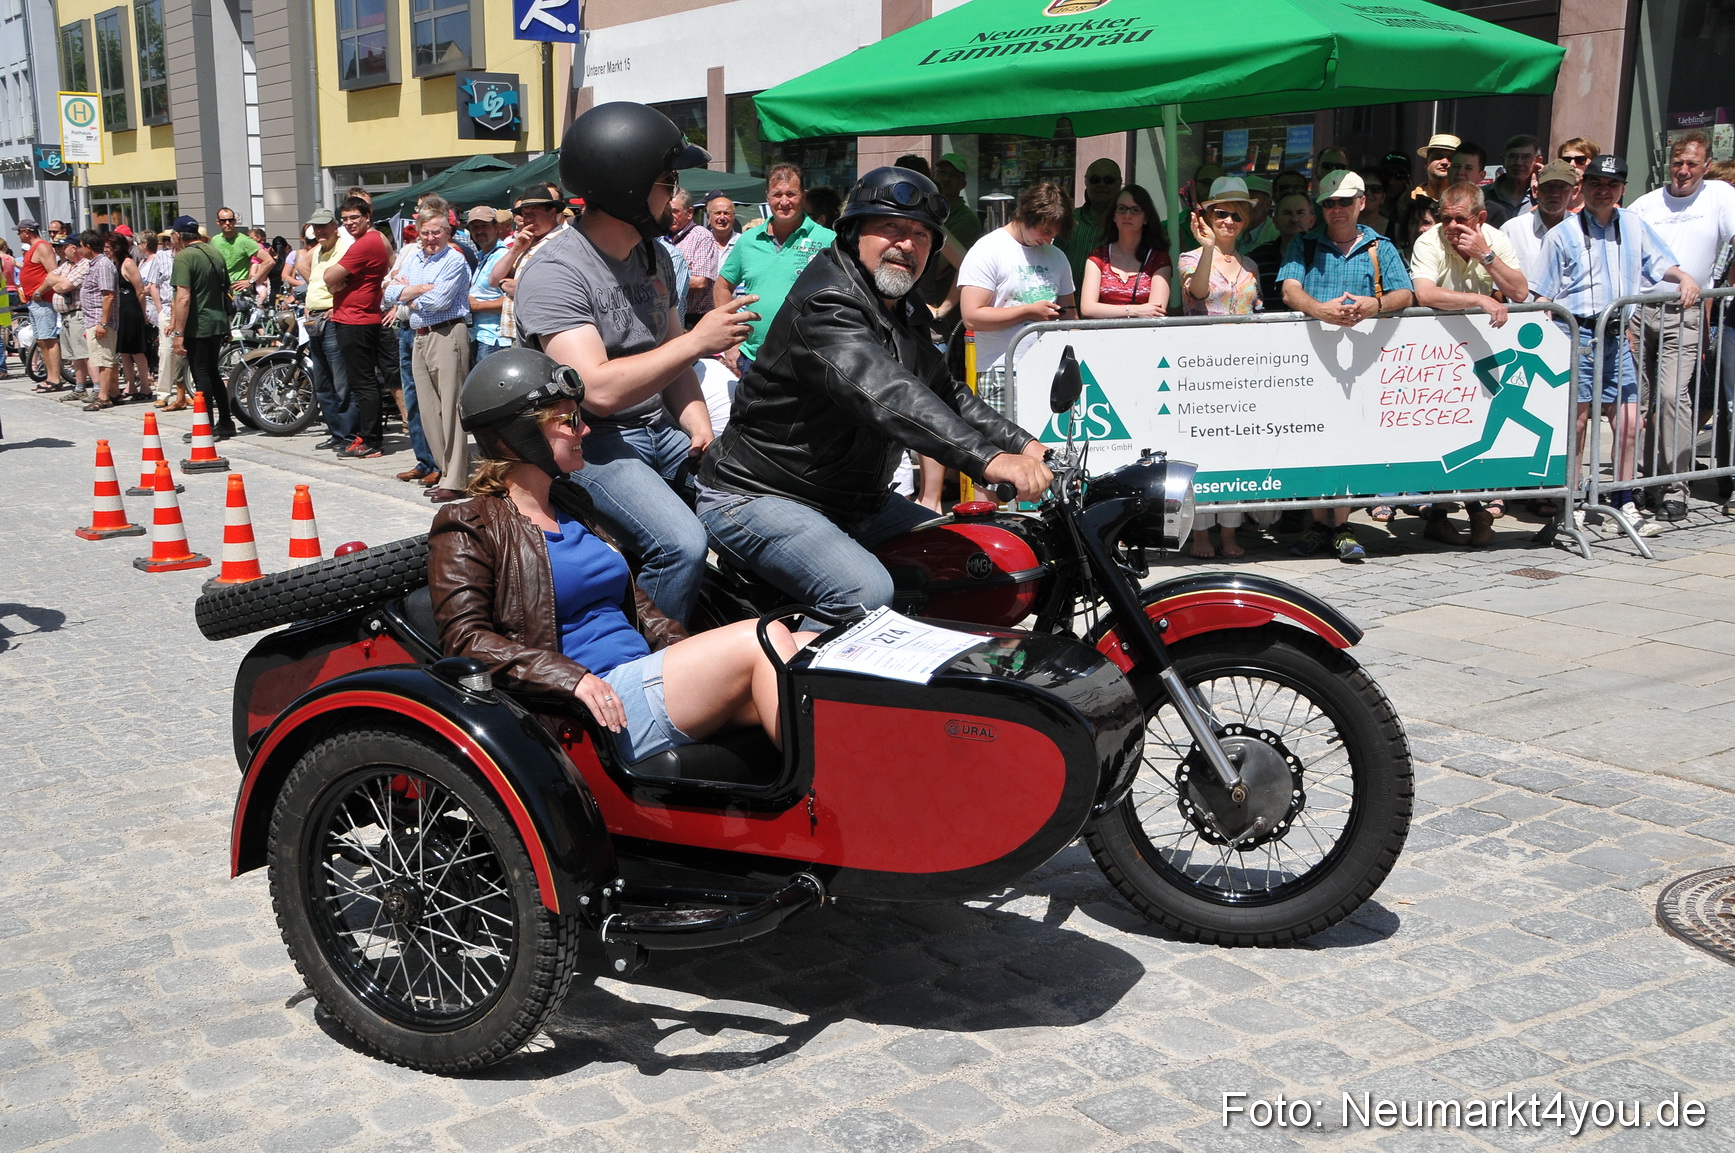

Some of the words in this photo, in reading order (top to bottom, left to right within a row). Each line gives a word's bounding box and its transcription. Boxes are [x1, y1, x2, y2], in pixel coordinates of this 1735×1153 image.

[968, 16, 1141, 44] Neumarkter
[917, 28, 1154, 66] Lammsbräu
[586, 64, 606, 77] Unterer
[606, 60, 623, 74] Markt
[624, 57, 631, 71] 15
[483, 91, 505, 119] G2
[1420, 341, 1468, 361] UNS
[1177, 352, 1309, 369] Gebäudereinigung
[1177, 375, 1314, 392] Hausmeisterdienste
[1177, 401, 1257, 416] Mietservice
[1379, 408, 1474, 428] BESSER.
[1190, 421, 1325, 438] Event-Leit-Systeme
[1111, 442, 1133, 452] GmbH
[1193, 476, 1282, 494] eservice.de
[871, 628, 911, 645] 274
[962, 724, 995, 738] URAL
